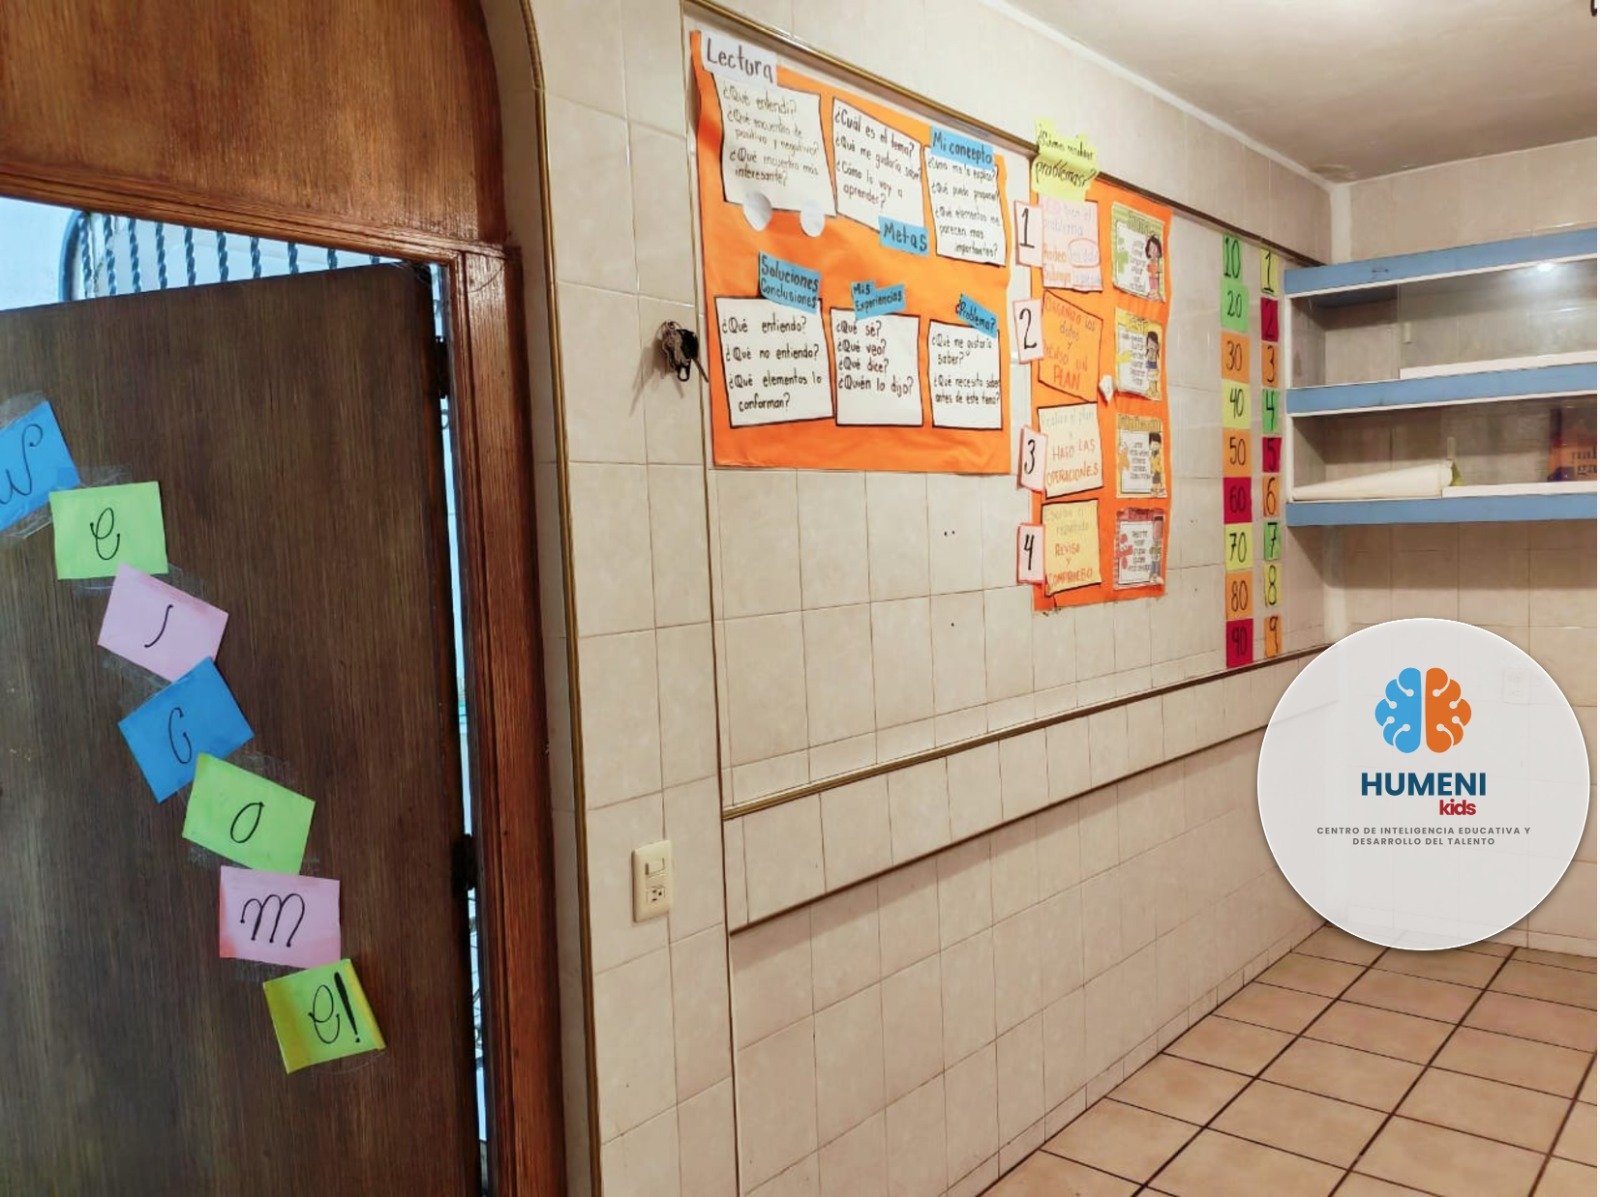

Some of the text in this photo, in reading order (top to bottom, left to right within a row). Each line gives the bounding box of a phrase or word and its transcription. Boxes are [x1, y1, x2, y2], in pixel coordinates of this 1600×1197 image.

[707, 37, 774, 83] Lectura
[865, 126, 876, 139] es
[932, 131, 992, 165] Mi concepto
[1019, 208, 1035, 249] 1
[761, 255, 819, 291] Soluciones
[1224, 237, 1241, 279] 10
[1264, 250, 1274, 294] 1
[761, 278, 817, 308] Conclusiones
[854, 284, 870, 295] Mis
[856, 287, 902, 313] Experiencias
[1227, 290, 1242, 318] 20
[722, 313, 807, 335] ¿Qué entiendo?
[837, 319, 857, 334] ¿Qué
[1019, 308, 1037, 349] 2
[1264, 300, 1274, 336] 2
[726, 343, 819, 362] ¿Qué no entiendo?
[837, 338, 886, 356] ¿Qué veo?
[1226, 340, 1242, 371] 30
[729, 367, 822, 389] ¿Qué elementos lo
[838, 356, 889, 373] ¿Qué dice?
[1267, 345, 1275, 383] 3
[838, 372, 914, 398] ¿Quién lo dijo?
[738, 392, 791, 412] conforman?
[1229, 388, 1244, 419] 40
[1264, 389, 1275, 431] 4
[1024, 439, 1035, 475] 3
[1229, 434, 1246, 466] 50
[1267, 433, 1275, 472] 5
[1229, 485, 1246, 513] 60
[1266, 477, 1276, 515] 6
[1024, 534, 1034, 570] 4
[1229, 532, 1247, 563] 70
[1267, 522, 1278, 557] 7
[1231, 580, 1248, 612] 80
[1268, 565, 1277, 605] 8
[1232, 626, 1248, 656] 90
[1269, 616, 1278, 654] 9
